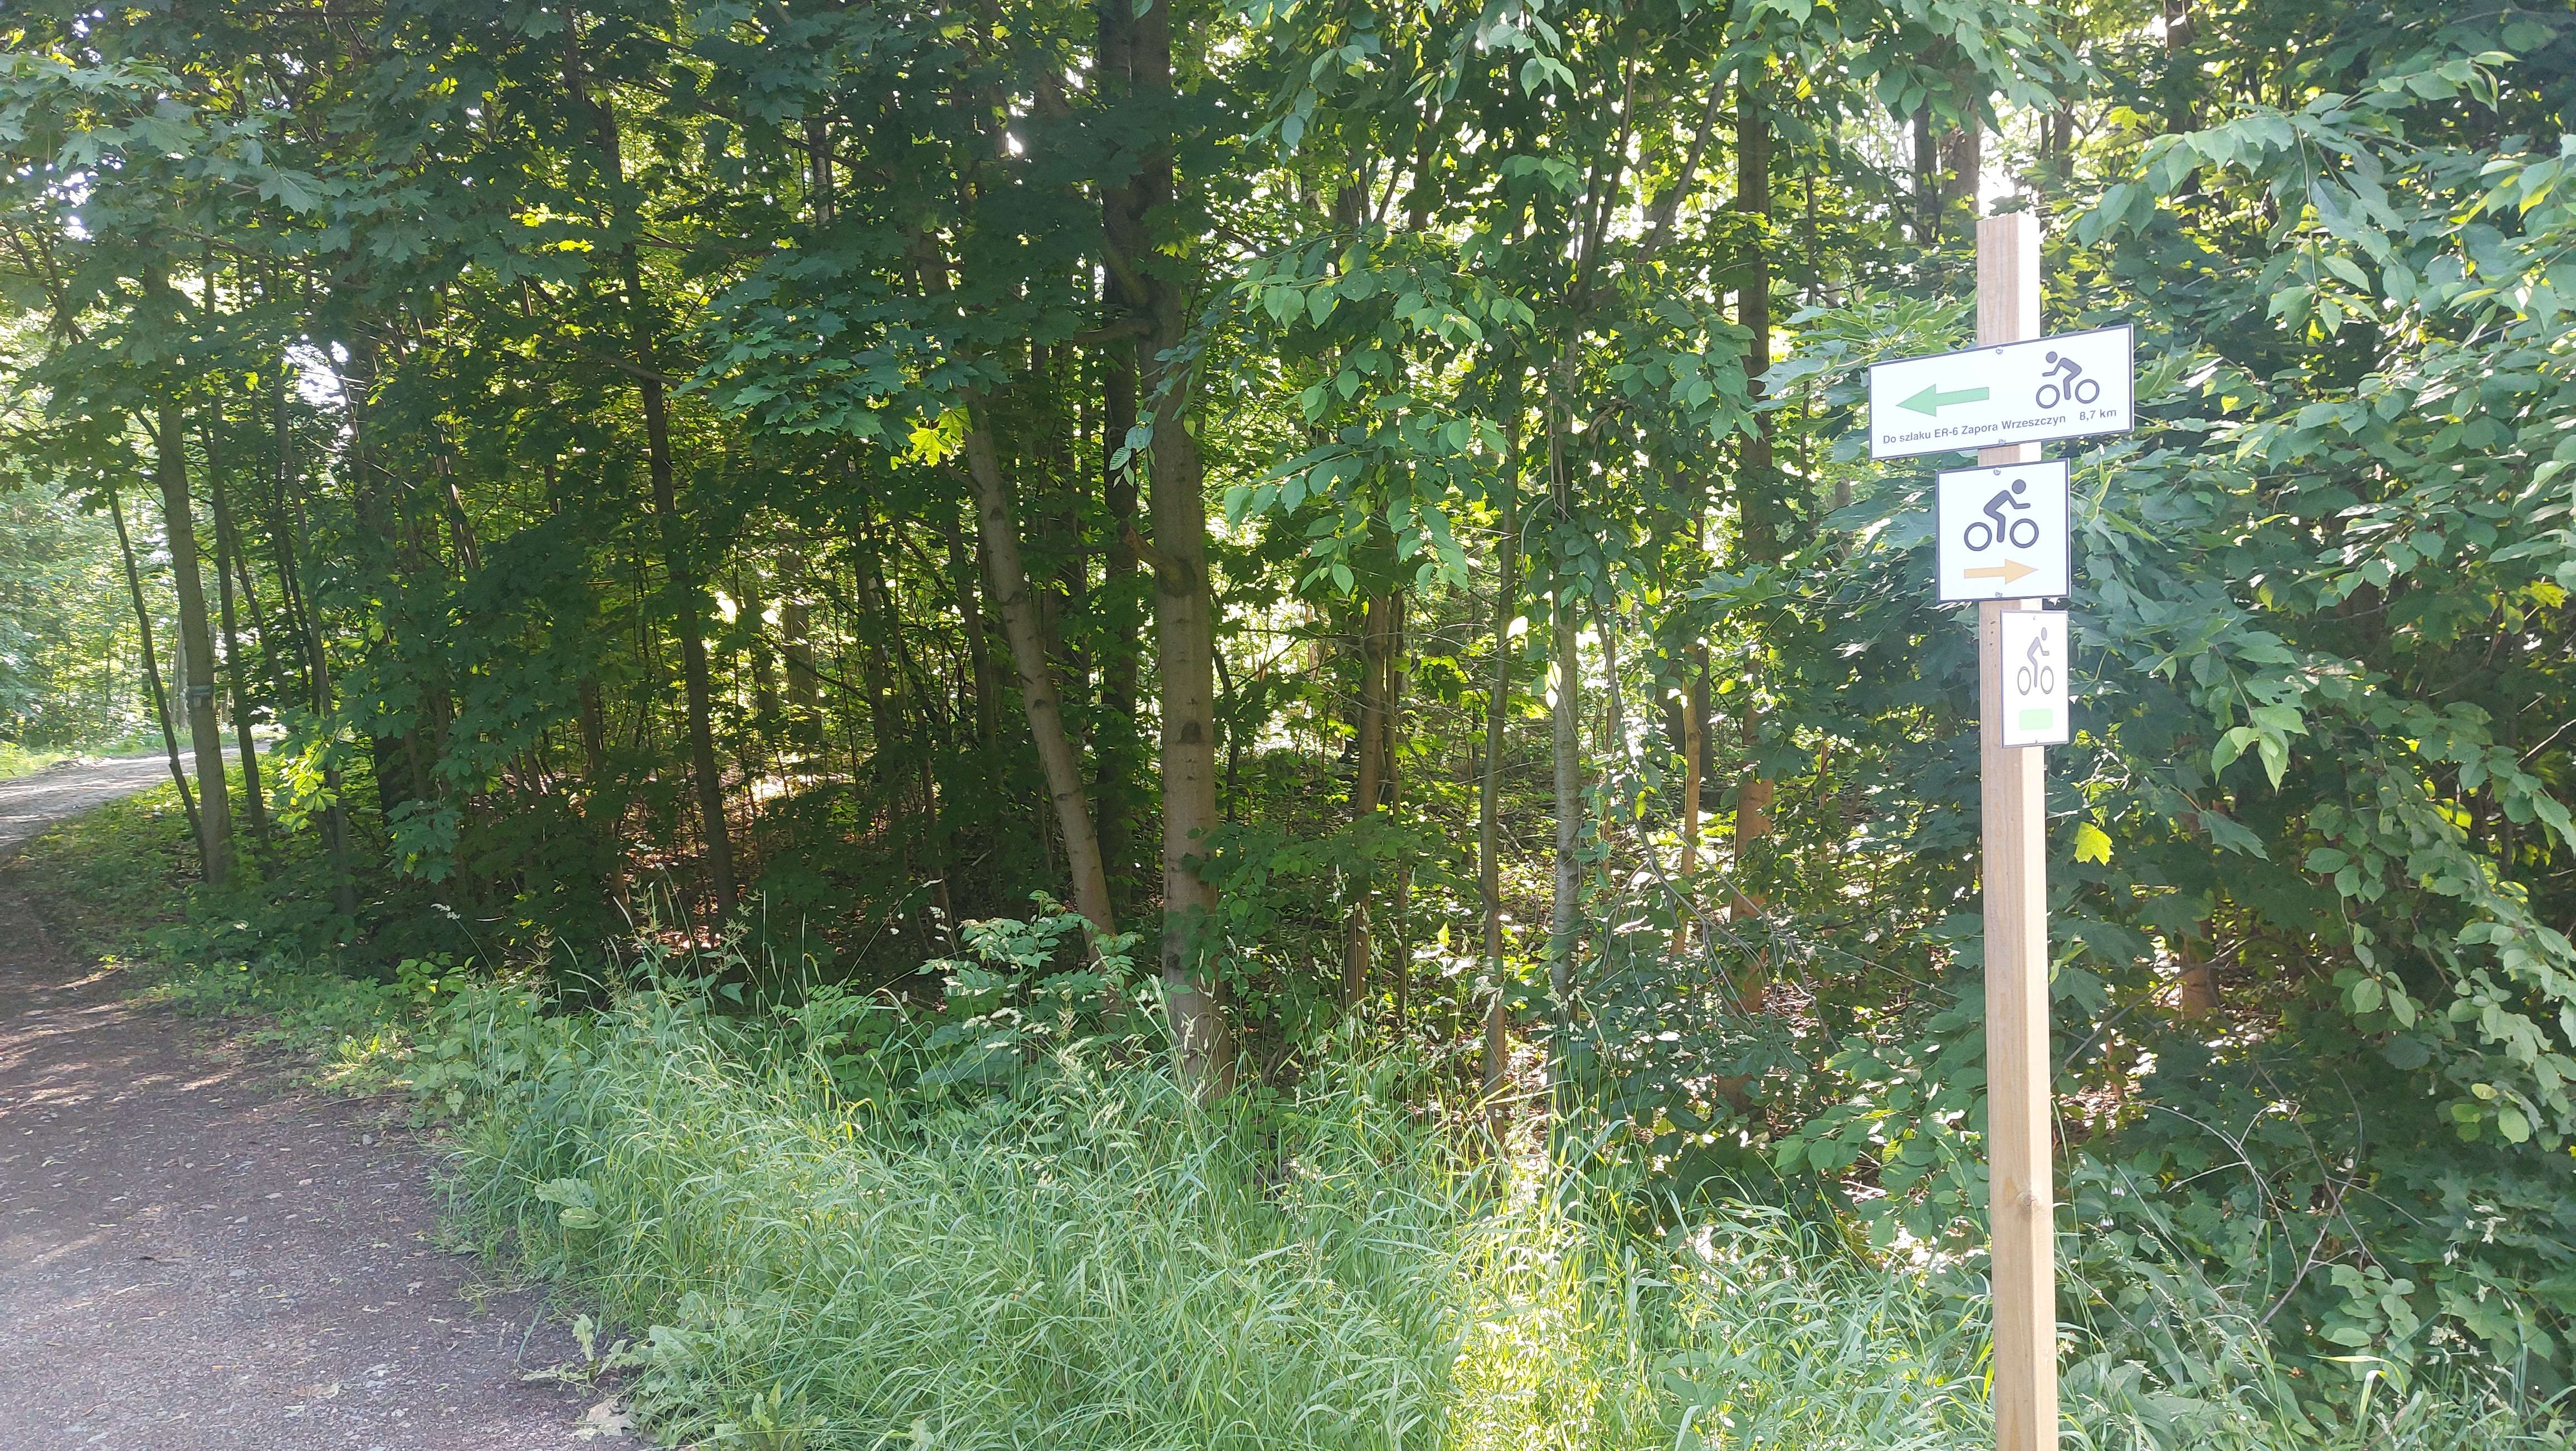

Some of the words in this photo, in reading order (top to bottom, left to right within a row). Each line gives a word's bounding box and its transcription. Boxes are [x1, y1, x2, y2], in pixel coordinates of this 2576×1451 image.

[1882, 435, 1896, 444] Do
[1899, 431, 1931, 442] szlaku
[1934, 427, 1958, 437] ER-6
[1961, 422, 1998, 435] Zapora
[2001, 415, 2066, 430] Wrzeszczyn
[2080, 410, 2096, 421] 8,7
[2100, 409, 2116, 418] km
